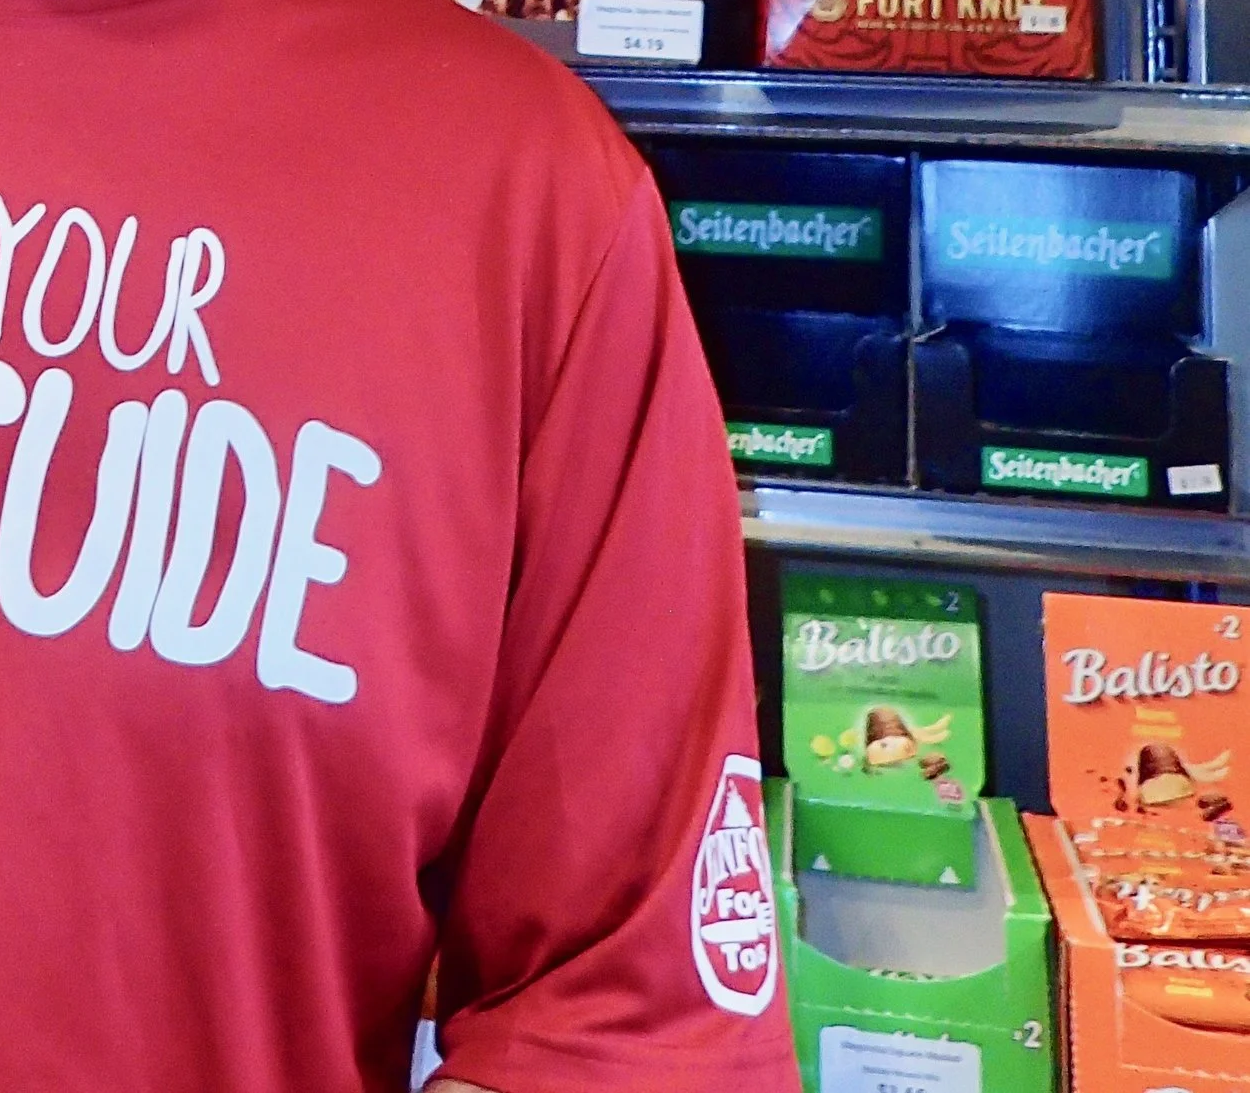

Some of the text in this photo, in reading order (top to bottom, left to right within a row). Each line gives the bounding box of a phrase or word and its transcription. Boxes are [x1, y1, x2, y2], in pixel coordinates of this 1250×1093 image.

[624, 37, 665, 51] $4.19
[677, 206, 873, 248] Seitenbacher
[948, 221, 1161, 270] Seitenbacher
[727, 423, 824, 458] enbacher
[987, 451, 1141, 492] Seitenbacher
[798, 619, 962, 673] Balisto
[1062, 647, 1241, 704] Balisto
